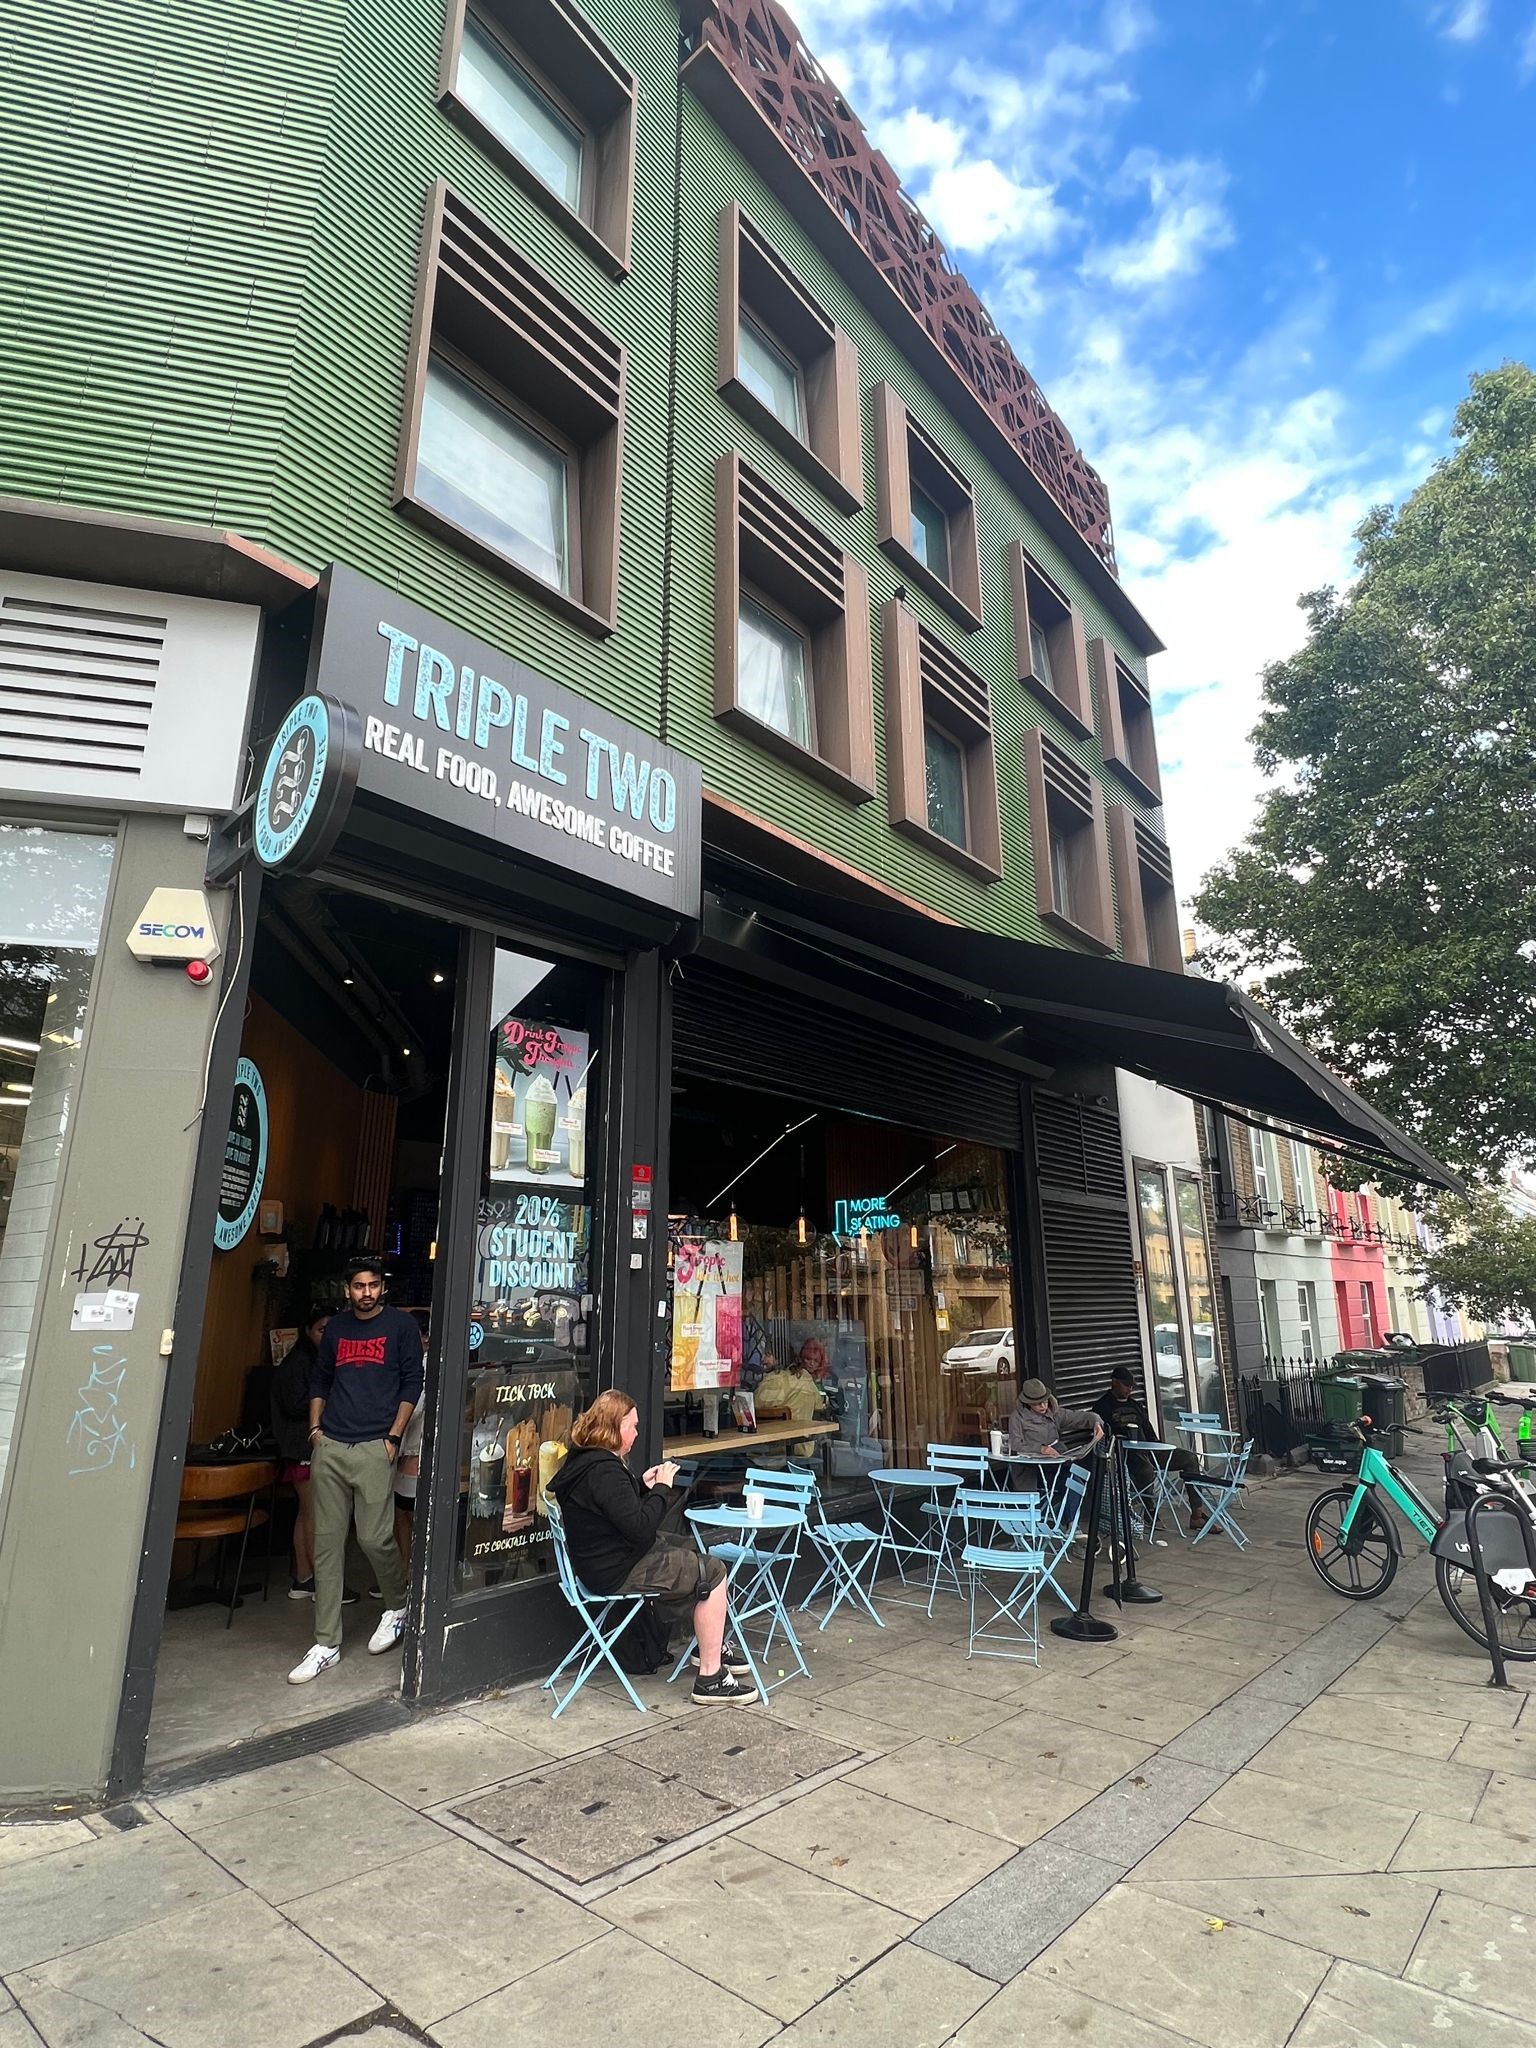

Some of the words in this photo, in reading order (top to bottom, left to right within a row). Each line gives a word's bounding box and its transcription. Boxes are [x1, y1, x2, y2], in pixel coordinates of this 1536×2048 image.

[276, 707, 302, 750] TRIPLE
[305, 703, 319, 720] TWO
[377, 620, 570, 785] TRIPLE
[578, 728, 676, 833] TWO
[273, 804, 309, 857] AWESOME
[310, 734, 327, 799] COFFEE
[364, 715, 429, 773] REAL
[435, 746, 501, 807] FOOD,
[506, 781, 606, 849] AWESOME
[608, 825, 675, 877] COFFEE
[139, 923, 205, 939] SECOM
[503, 1021, 545, 1045] Drink
[219, 1219, 247, 1243] AWESOME
[247, 1167, 264, 1218] COFFEE
[515, 1194, 560, 1227] 20%
[850, 1197, 886, 1211] MORE
[491, 1227, 577, 1259] STUDENT
[489, 1260, 577, 1288] DISCOUNT
[495, 1384, 527, 1403] TICK
[527, 1382, 557, 1400] TOCK
[1412, 1510, 1434, 1537] TIER
[473, 1541, 491, 1556] IT'S
[491, 1534, 529, 1552] COCKTAIL
